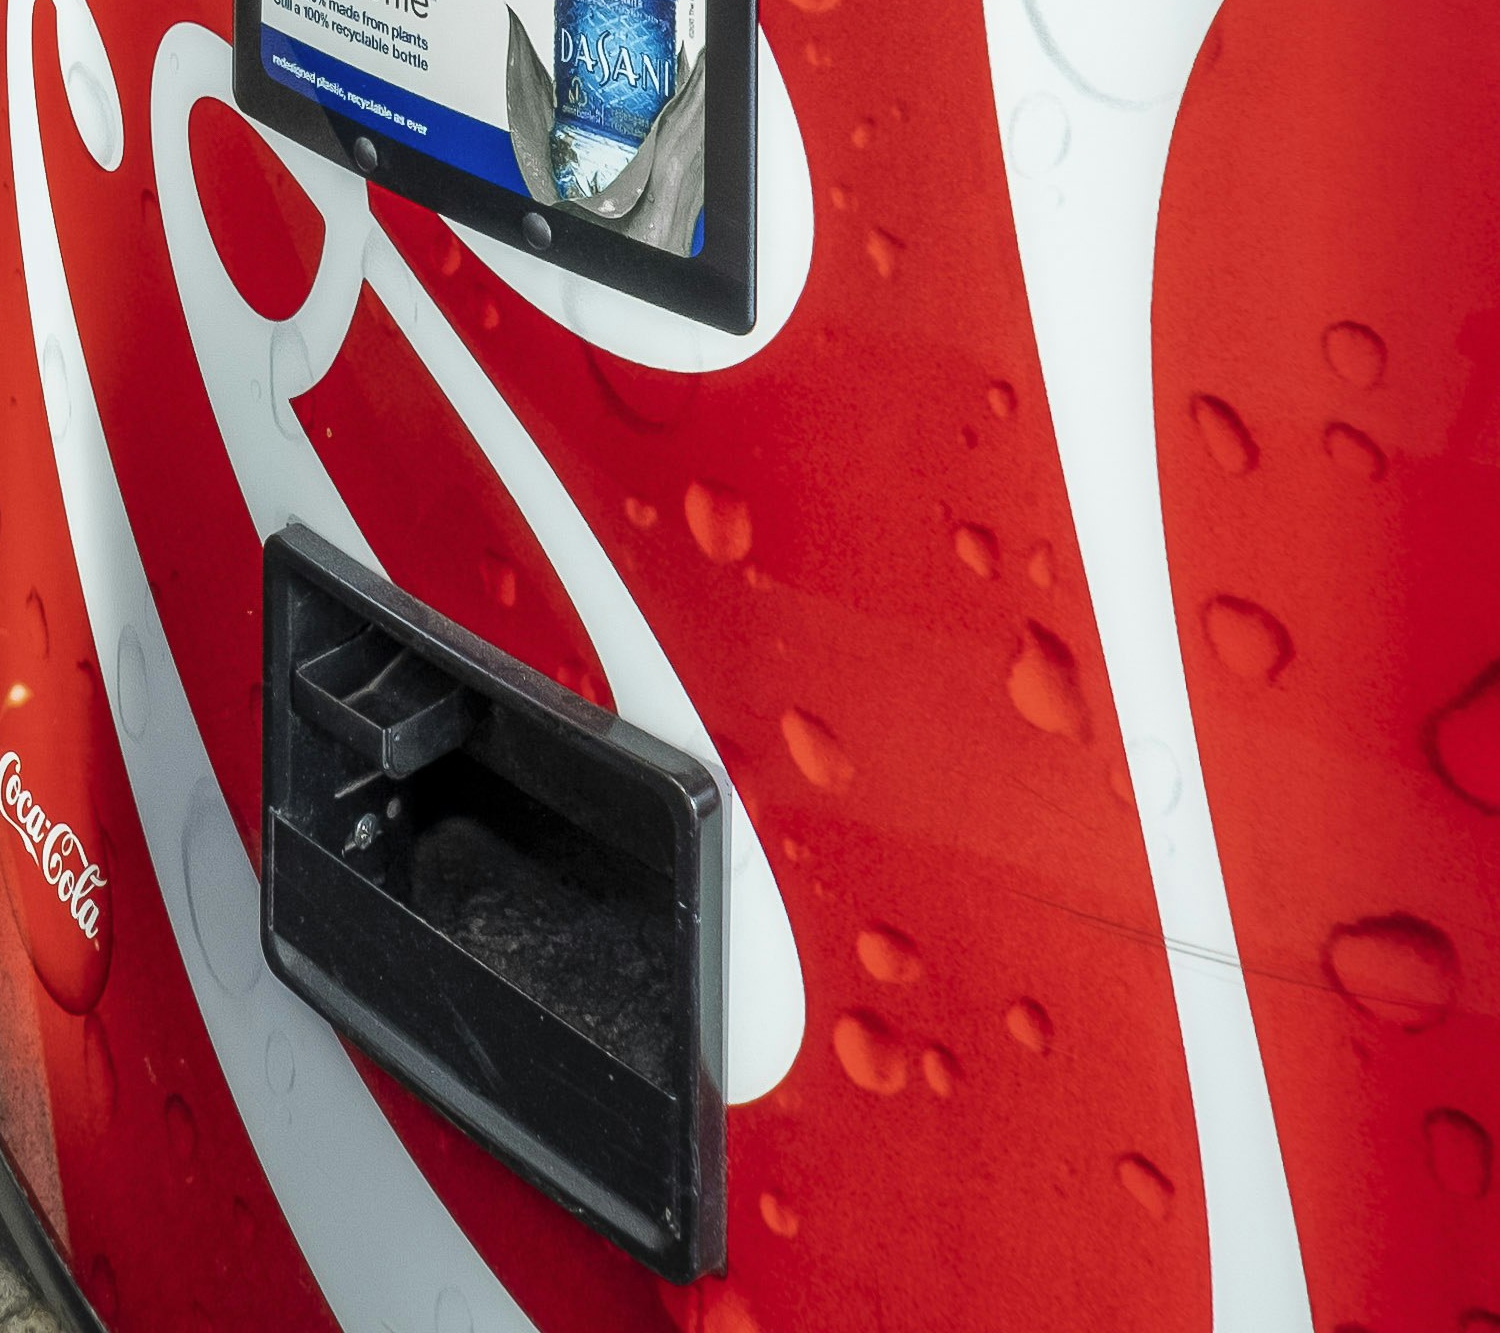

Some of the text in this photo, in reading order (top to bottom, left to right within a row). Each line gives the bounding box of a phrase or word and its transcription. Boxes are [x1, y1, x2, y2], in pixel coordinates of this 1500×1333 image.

[294, 3, 301, 16] a
[303, 5, 330, 30] 100%
[331, 20, 390, 55] recyclable
[392, 43, 429, 72] bottle
[362, 10, 390, 35] from
[391, 26, 429, 52] plants
[560, 27, 670, 98] DASANI
[272, 53, 429, 137] redesigned plastic, recyclable as ever
